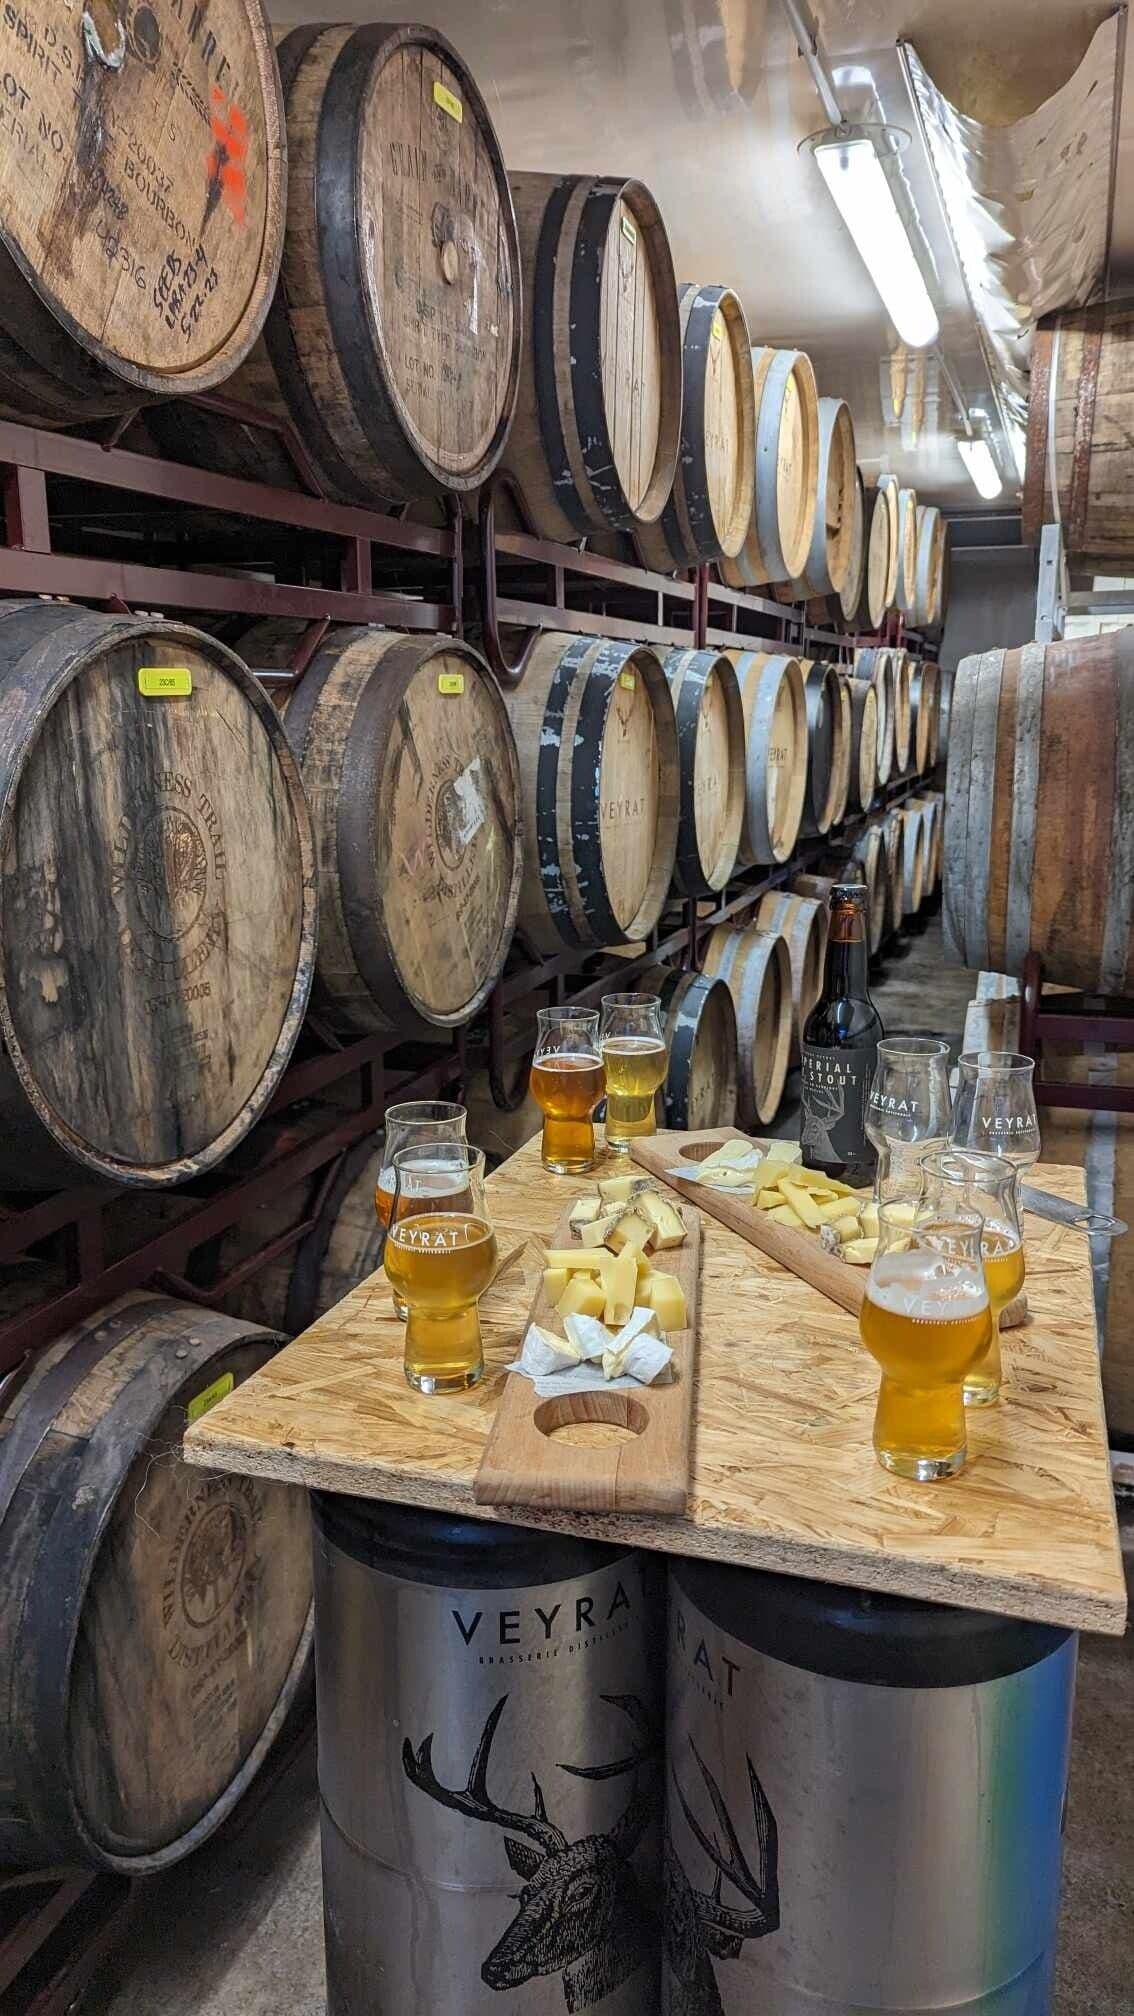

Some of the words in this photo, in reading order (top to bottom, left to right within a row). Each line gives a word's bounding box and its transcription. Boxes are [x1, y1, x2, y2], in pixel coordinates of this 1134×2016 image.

[4, 4, 62, 85] SPIRIT
[0, 72, 31, 111] OT
[124, 155, 196, 249] BOURBON
[600, 798, 645, 820] VEYRAT
[198, 794, 227, 880] TRAIL
[801, 1055, 852, 1073] PERIAL
[810, 1071, 857, 1086] STOUT
[869, 1090, 919, 1113] VEYRAT
[391, 1223, 458, 1247] VEYRAT
[452, 1581, 632, 1646] VEYRA
[676, 1608, 742, 1697] RAT
